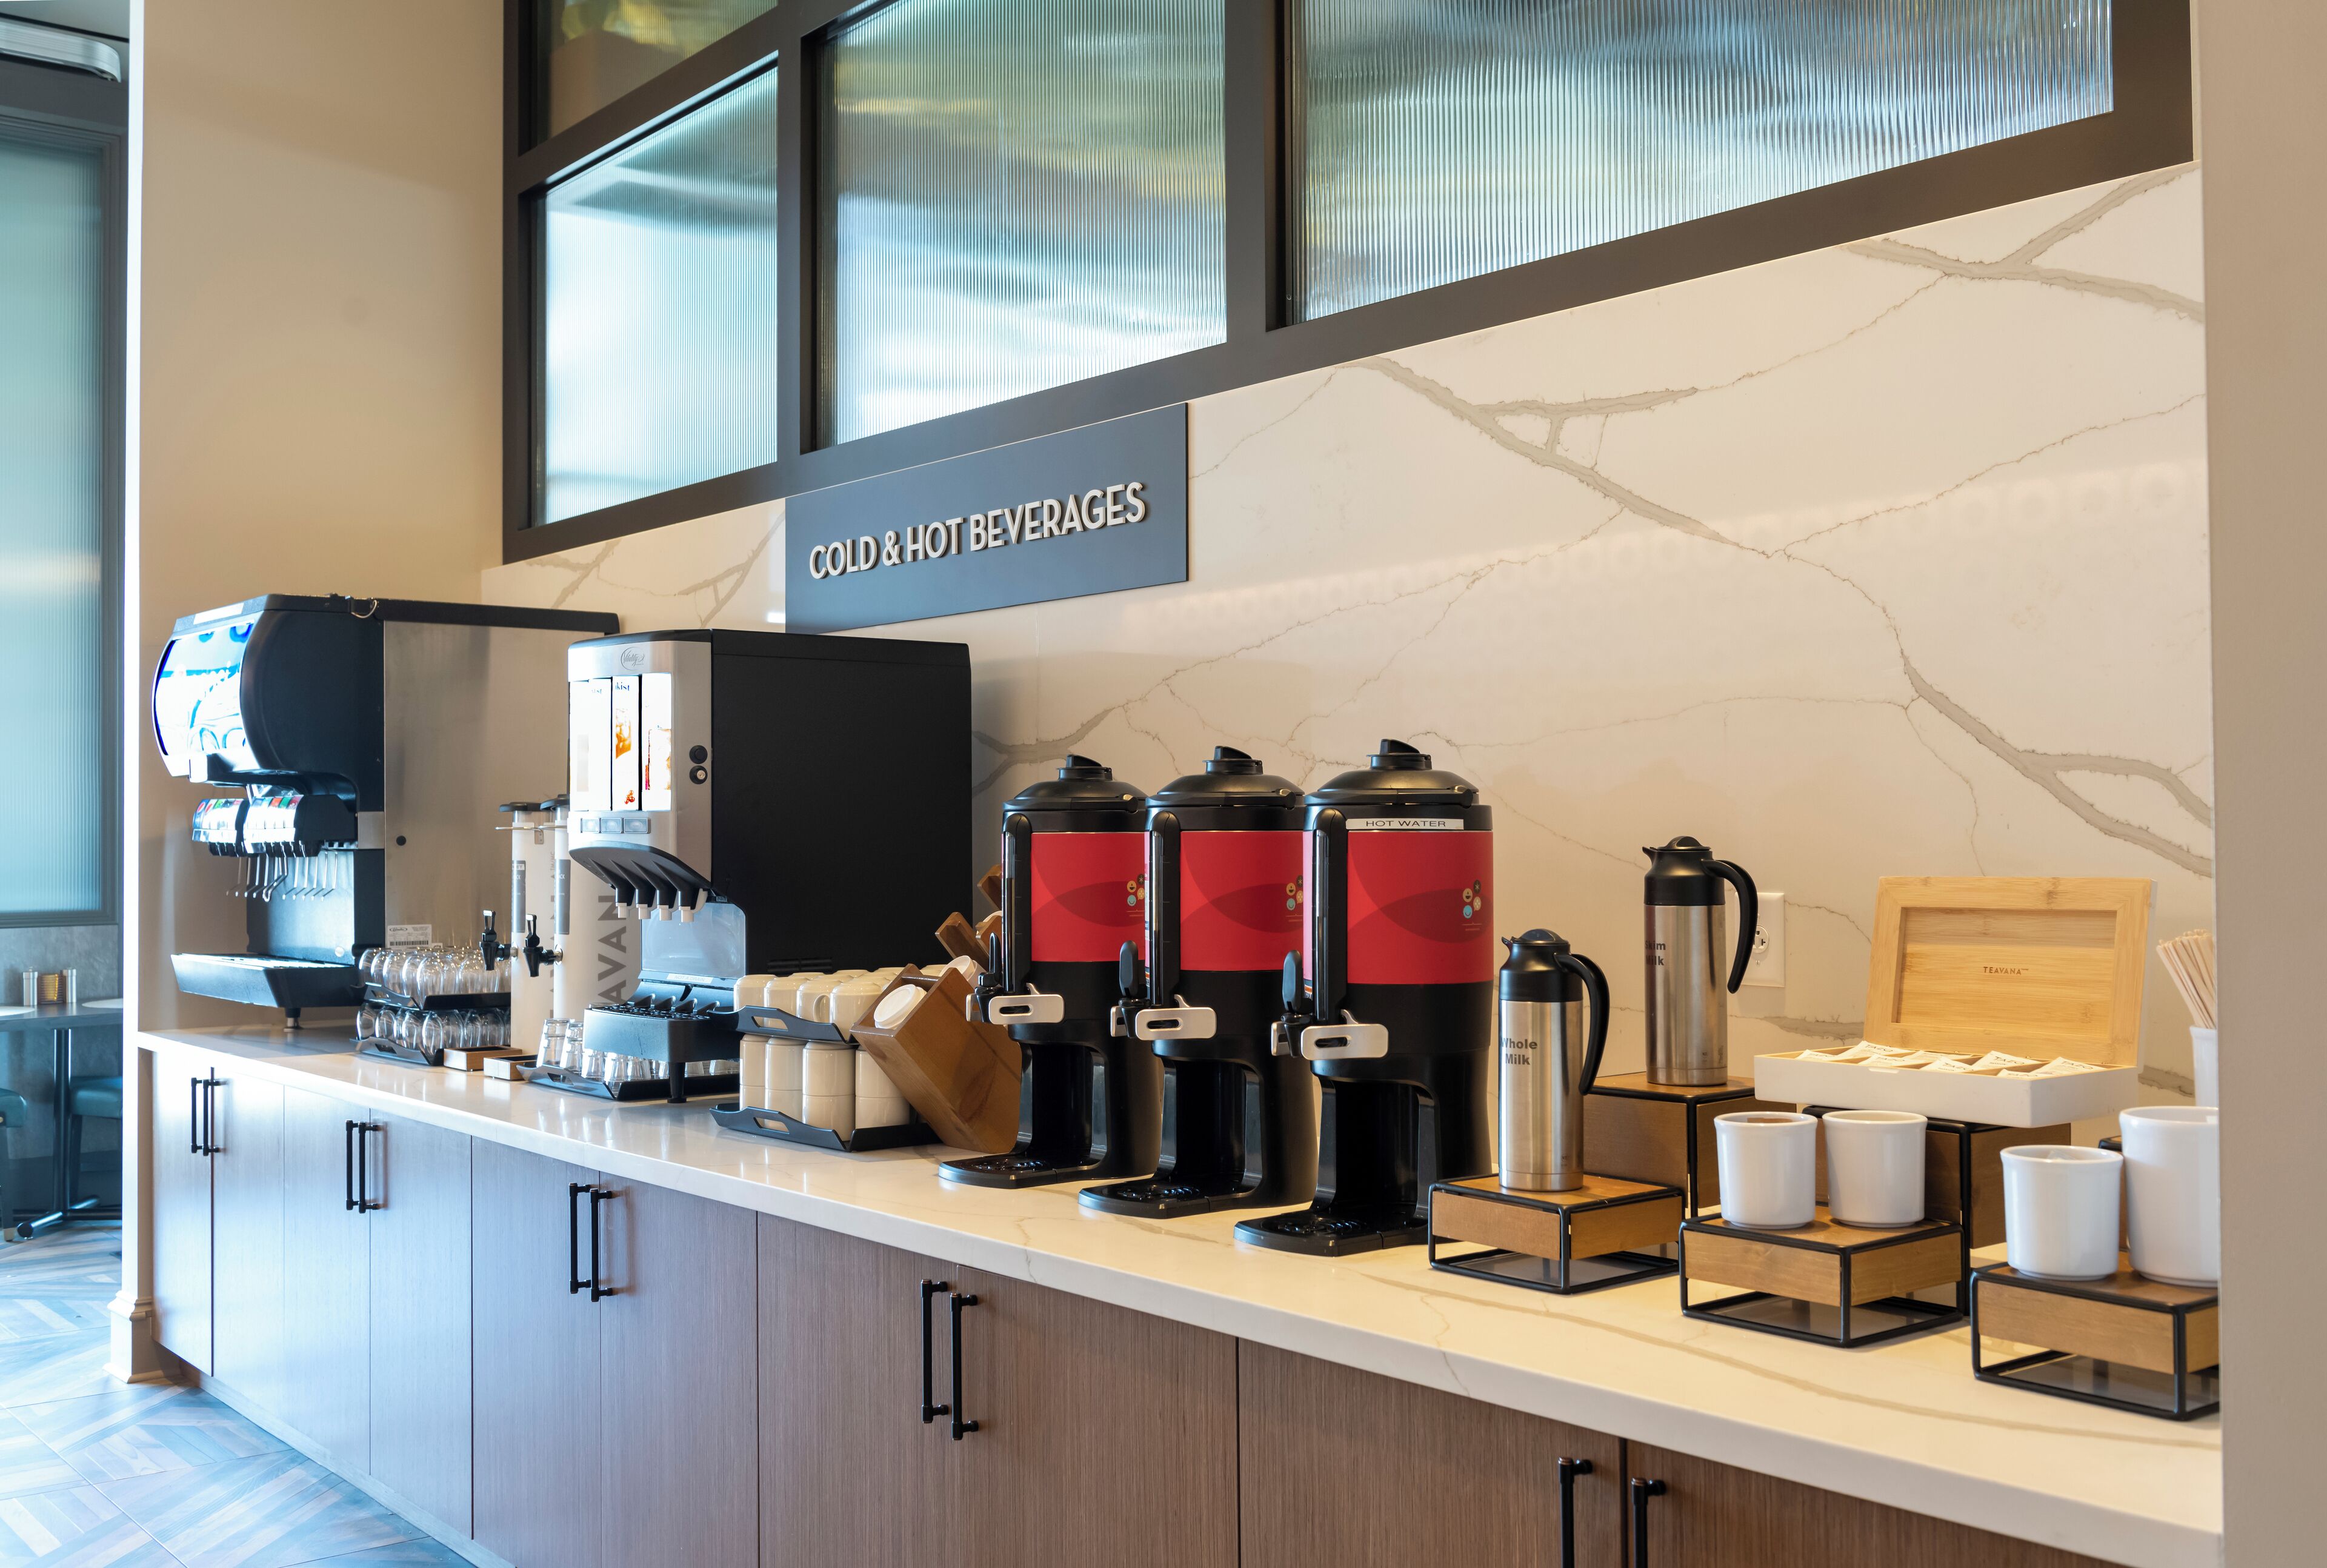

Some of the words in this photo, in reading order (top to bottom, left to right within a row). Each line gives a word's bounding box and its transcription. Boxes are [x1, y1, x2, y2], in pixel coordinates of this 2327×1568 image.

[809, 534, 878, 580] COLD
[882, 530, 904, 566] &
[907, 517, 965, 562] HOT
[970, 482, 1147, 552] BEVERAGES
[1645, 940, 1666, 951] Skim
[1646, 955, 1665, 966] Milk
[1983, 966, 2022, 975] TEAVANA
[1501, 1037, 1537, 1049] Whole
[1505, 1053, 1531, 1065] Milk
[1993, 1056, 2025, 1065] TAZO
[1942, 1062, 1974, 1072] TAZO
